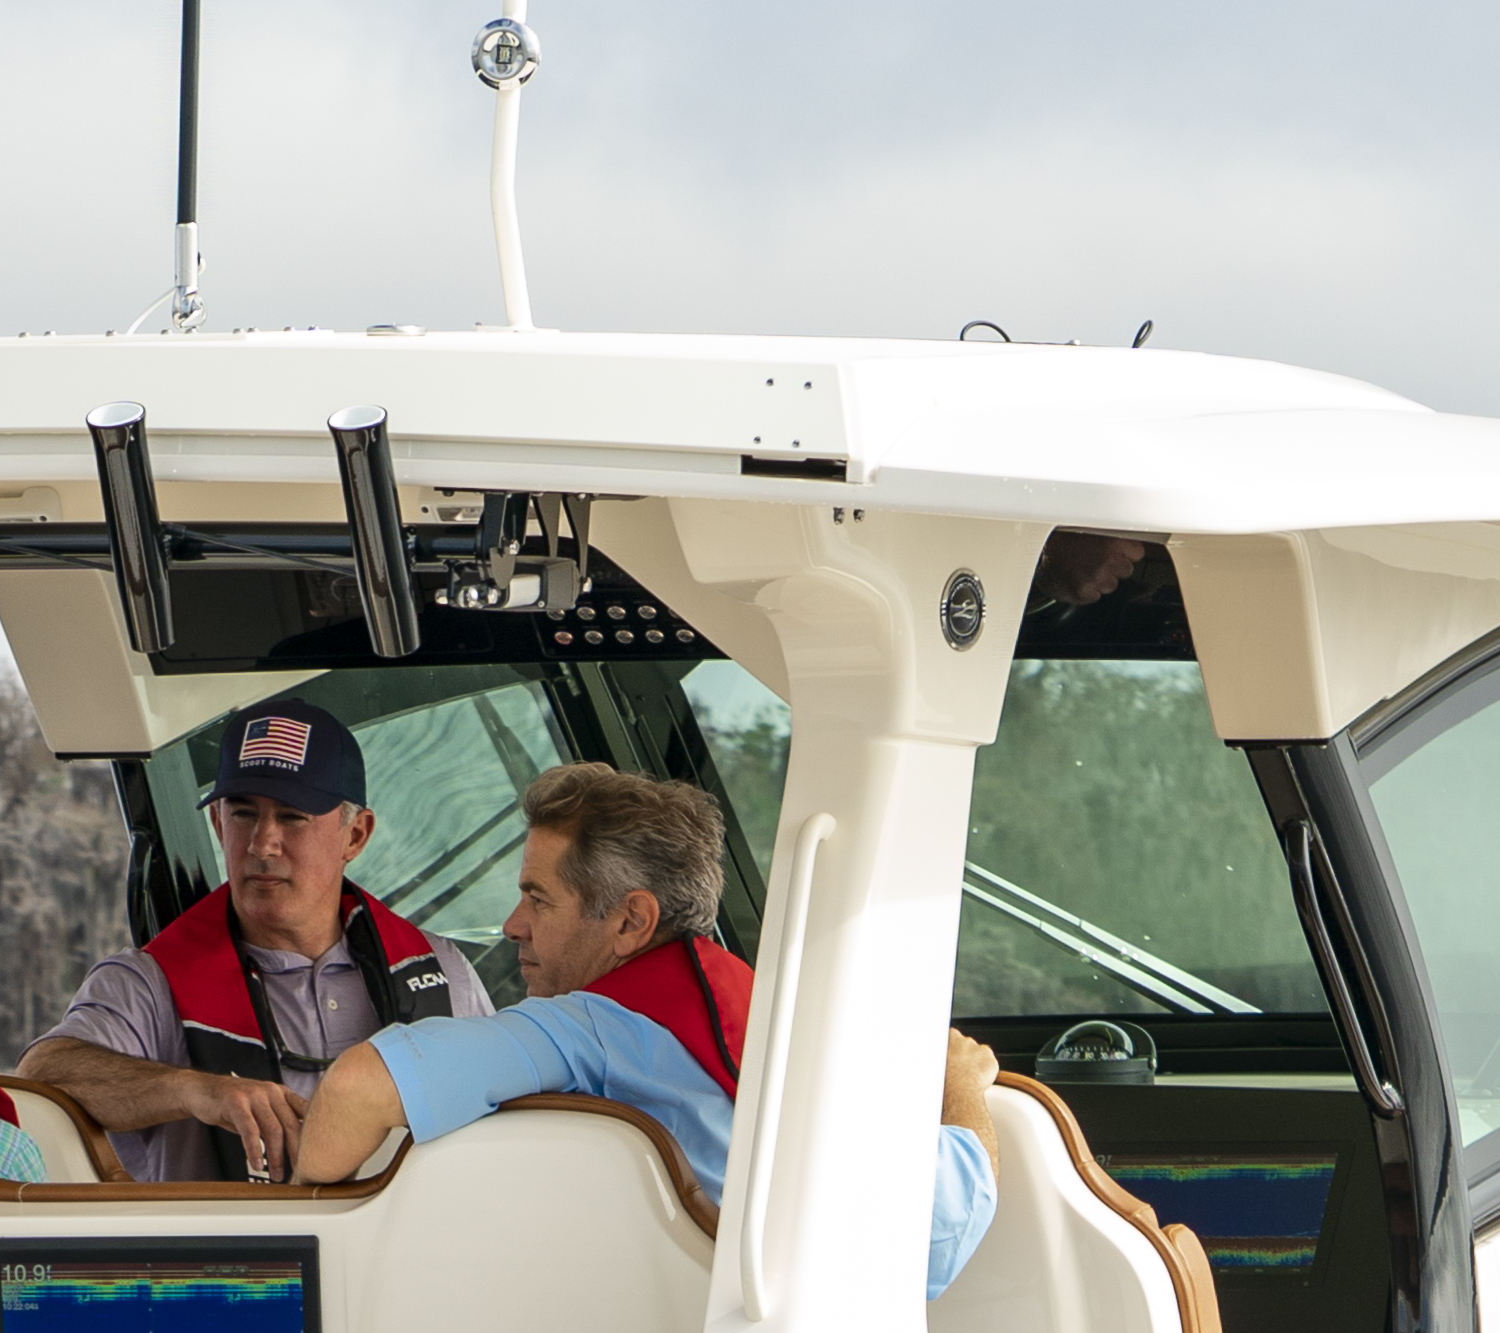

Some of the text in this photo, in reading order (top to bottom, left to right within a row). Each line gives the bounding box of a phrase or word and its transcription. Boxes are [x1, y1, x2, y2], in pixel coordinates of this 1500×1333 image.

[240, 760, 299, 771] SCOUT BOATS
[2, 1264, 45, 1283] 10.9
